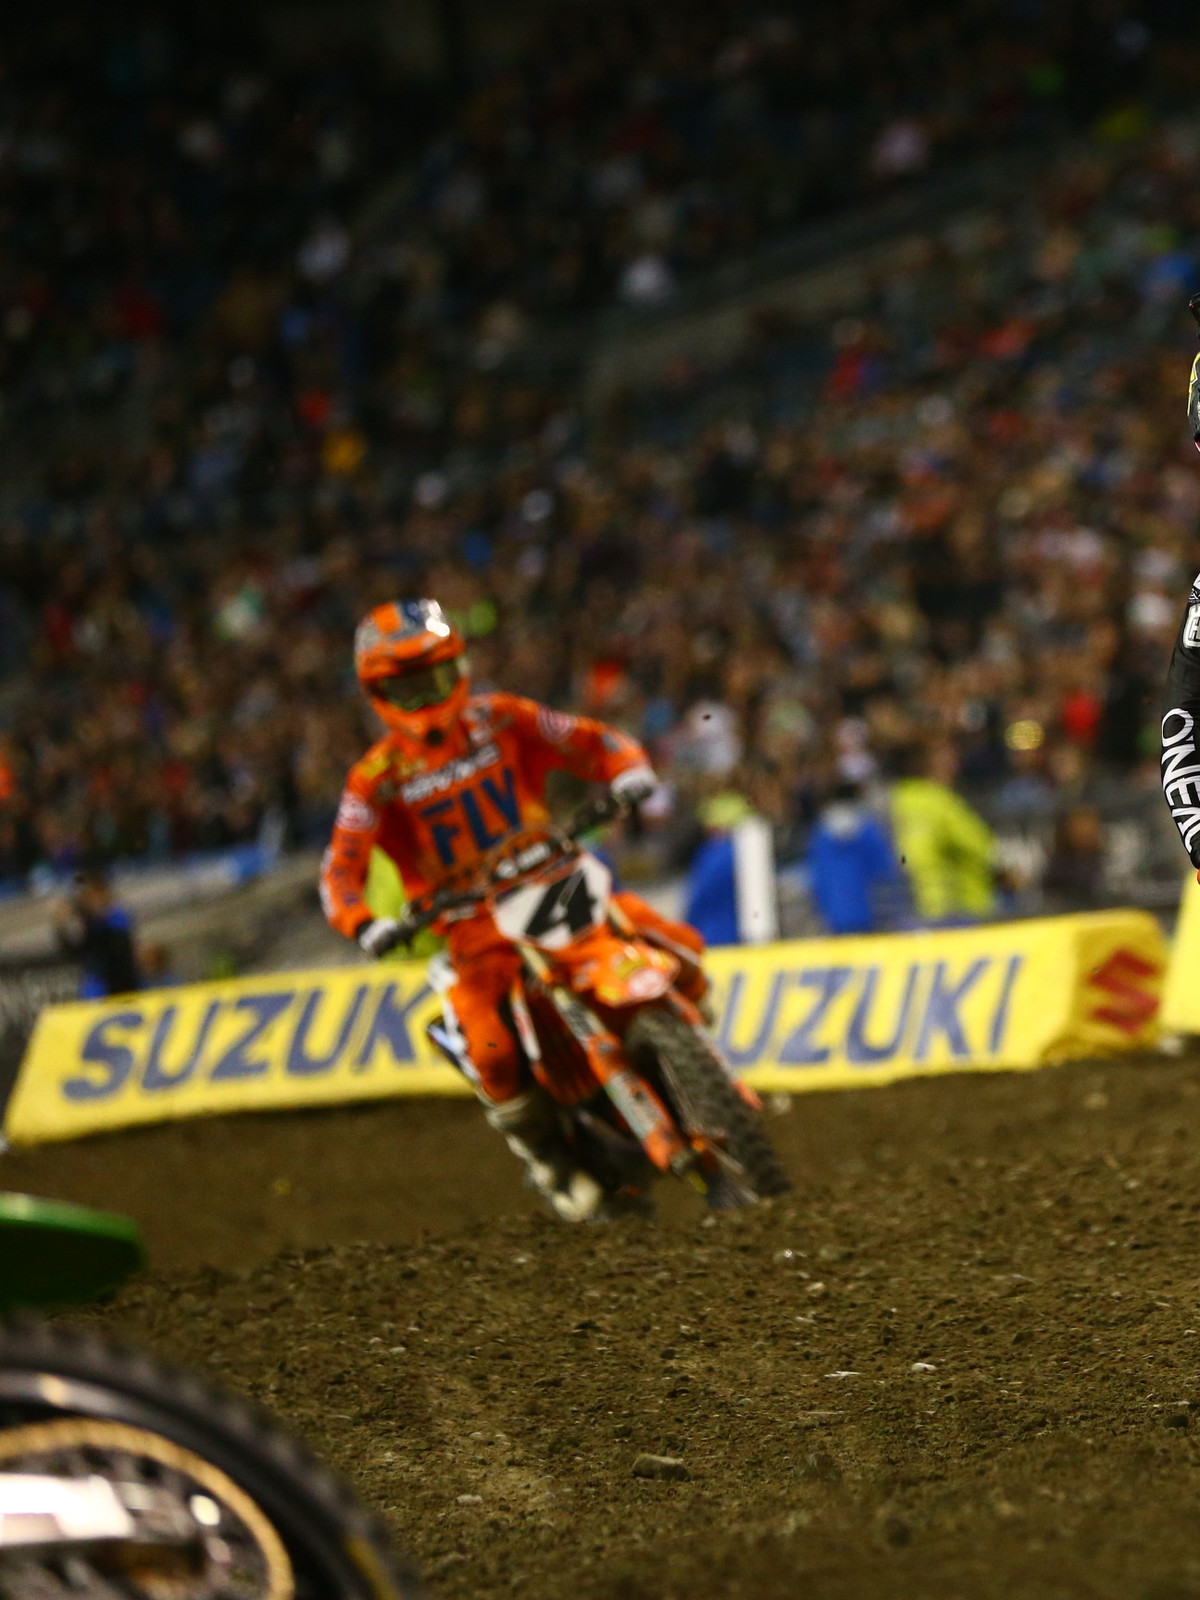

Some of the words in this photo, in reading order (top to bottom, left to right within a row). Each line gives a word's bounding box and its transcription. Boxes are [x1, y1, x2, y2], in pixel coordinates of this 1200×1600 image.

[420, 767, 523, 866] FLY
[526, 868, 595, 938] 4
[62, 980, 434, 1105] SUZUK
[708, 954, 1023, 1068] UZUKI
